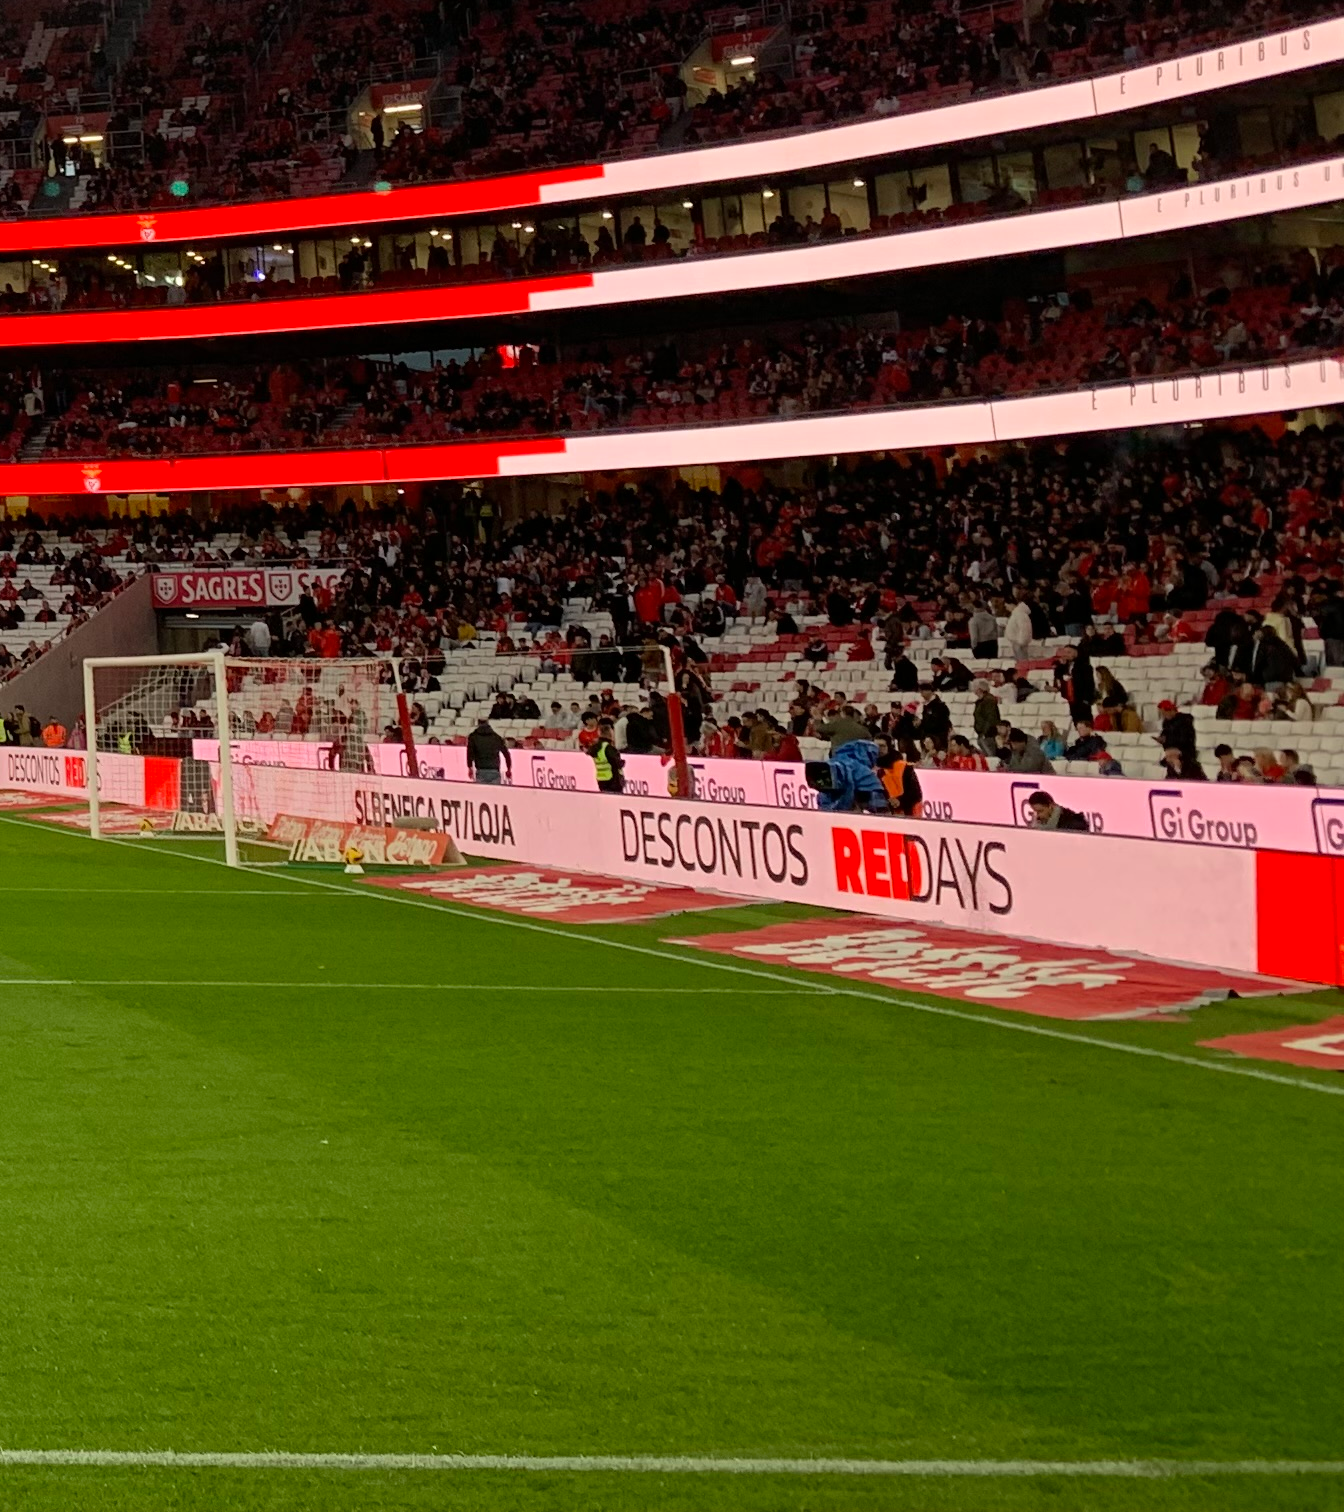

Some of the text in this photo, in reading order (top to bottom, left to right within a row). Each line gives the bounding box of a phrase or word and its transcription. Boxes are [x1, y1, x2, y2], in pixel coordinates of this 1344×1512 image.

[1119, 29, 1311, 95] E PLURIBUS
[1156, 197, 1163, 213] E
[1184, 171, 1301, 208] PLURIBUS
[1129, 365, 1292, 406] PLURIBUS
[180, 573, 264, 604] SAGRES
[7, 753, 61, 787] DESCONTOS
[535, 767, 547, 788] Gi
[547, 769, 578, 790] Group
[622, 778, 649, 798] roup
[707, 780, 746, 804] Group
[780, 782, 796, 808] Gi
[176, 810, 270, 833] ABACA
[922, 799, 954, 820] oup
[1160, 807, 1258, 848] Gi Group
[618, 807, 810, 887] DESCONTOS
